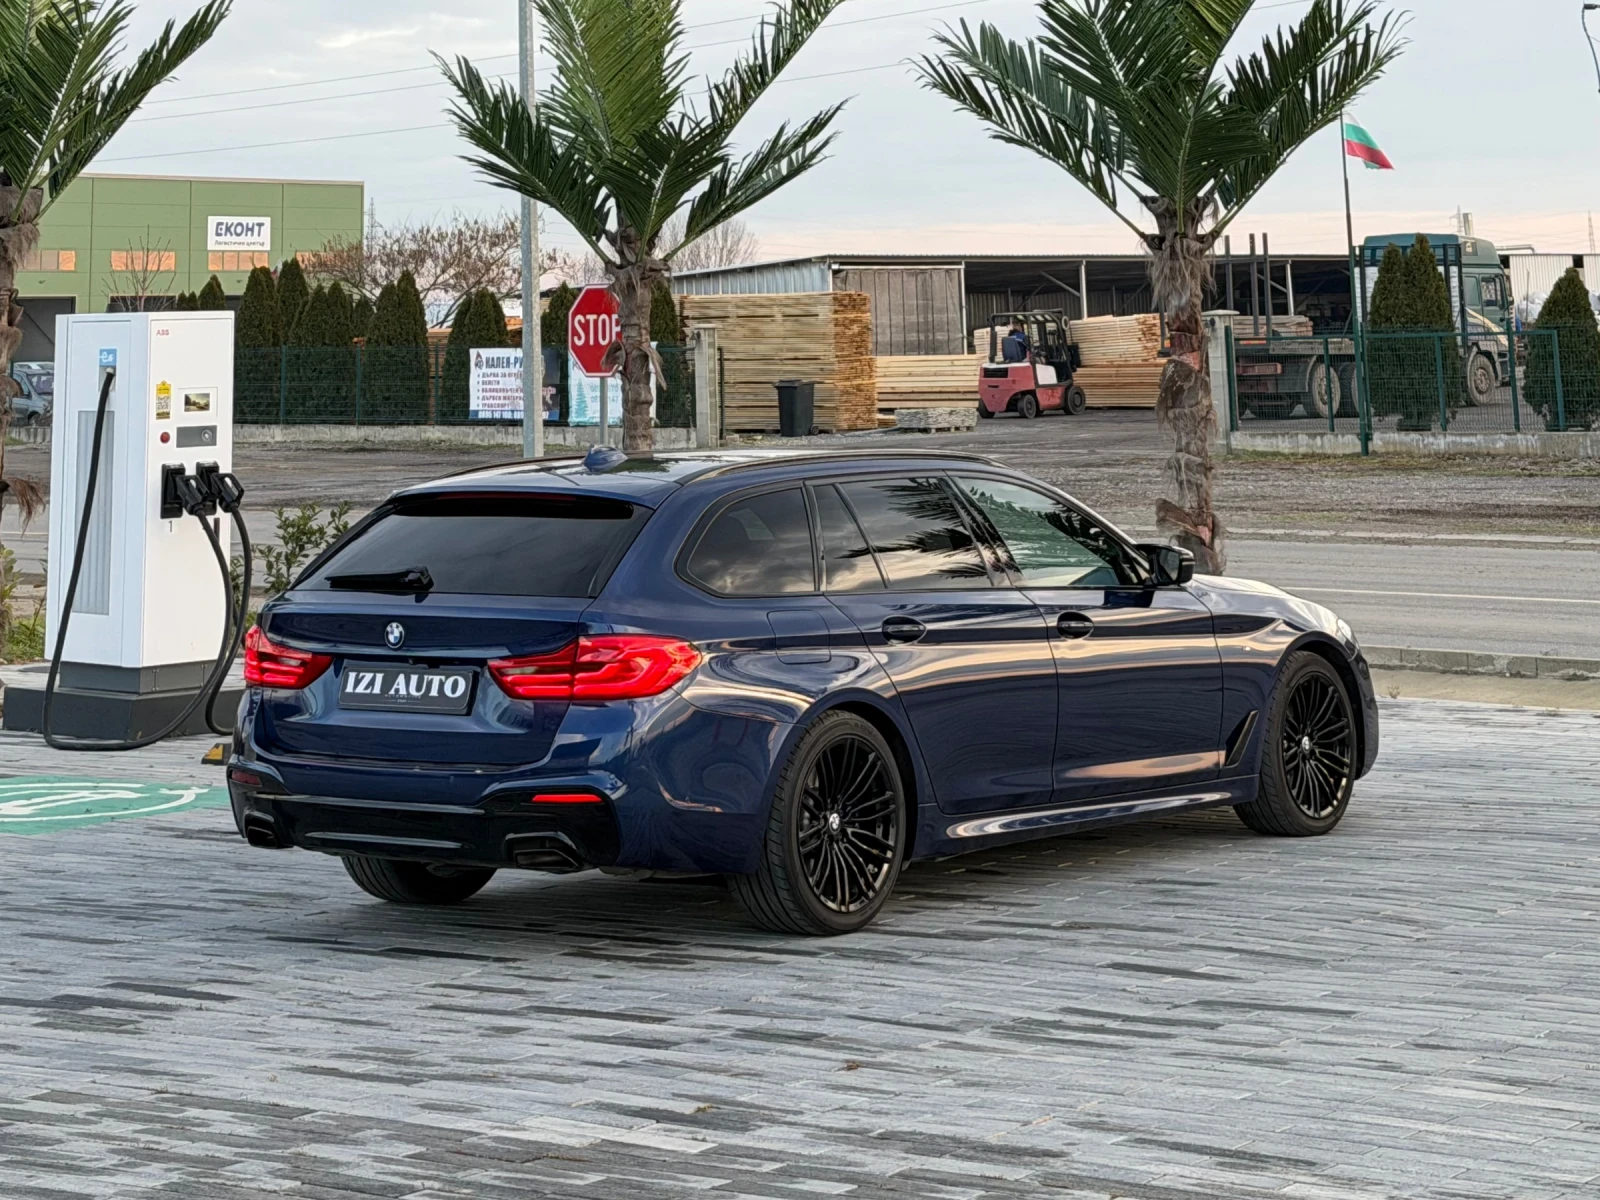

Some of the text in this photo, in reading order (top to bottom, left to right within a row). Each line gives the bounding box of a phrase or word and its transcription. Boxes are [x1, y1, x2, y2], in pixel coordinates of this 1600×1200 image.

[215, 221, 265, 237] ЕКОНТ
[573, 313, 621, 346] STOP
[168, 520, 173, 533] 1
[345, 671, 466, 698] IZI AUTO
